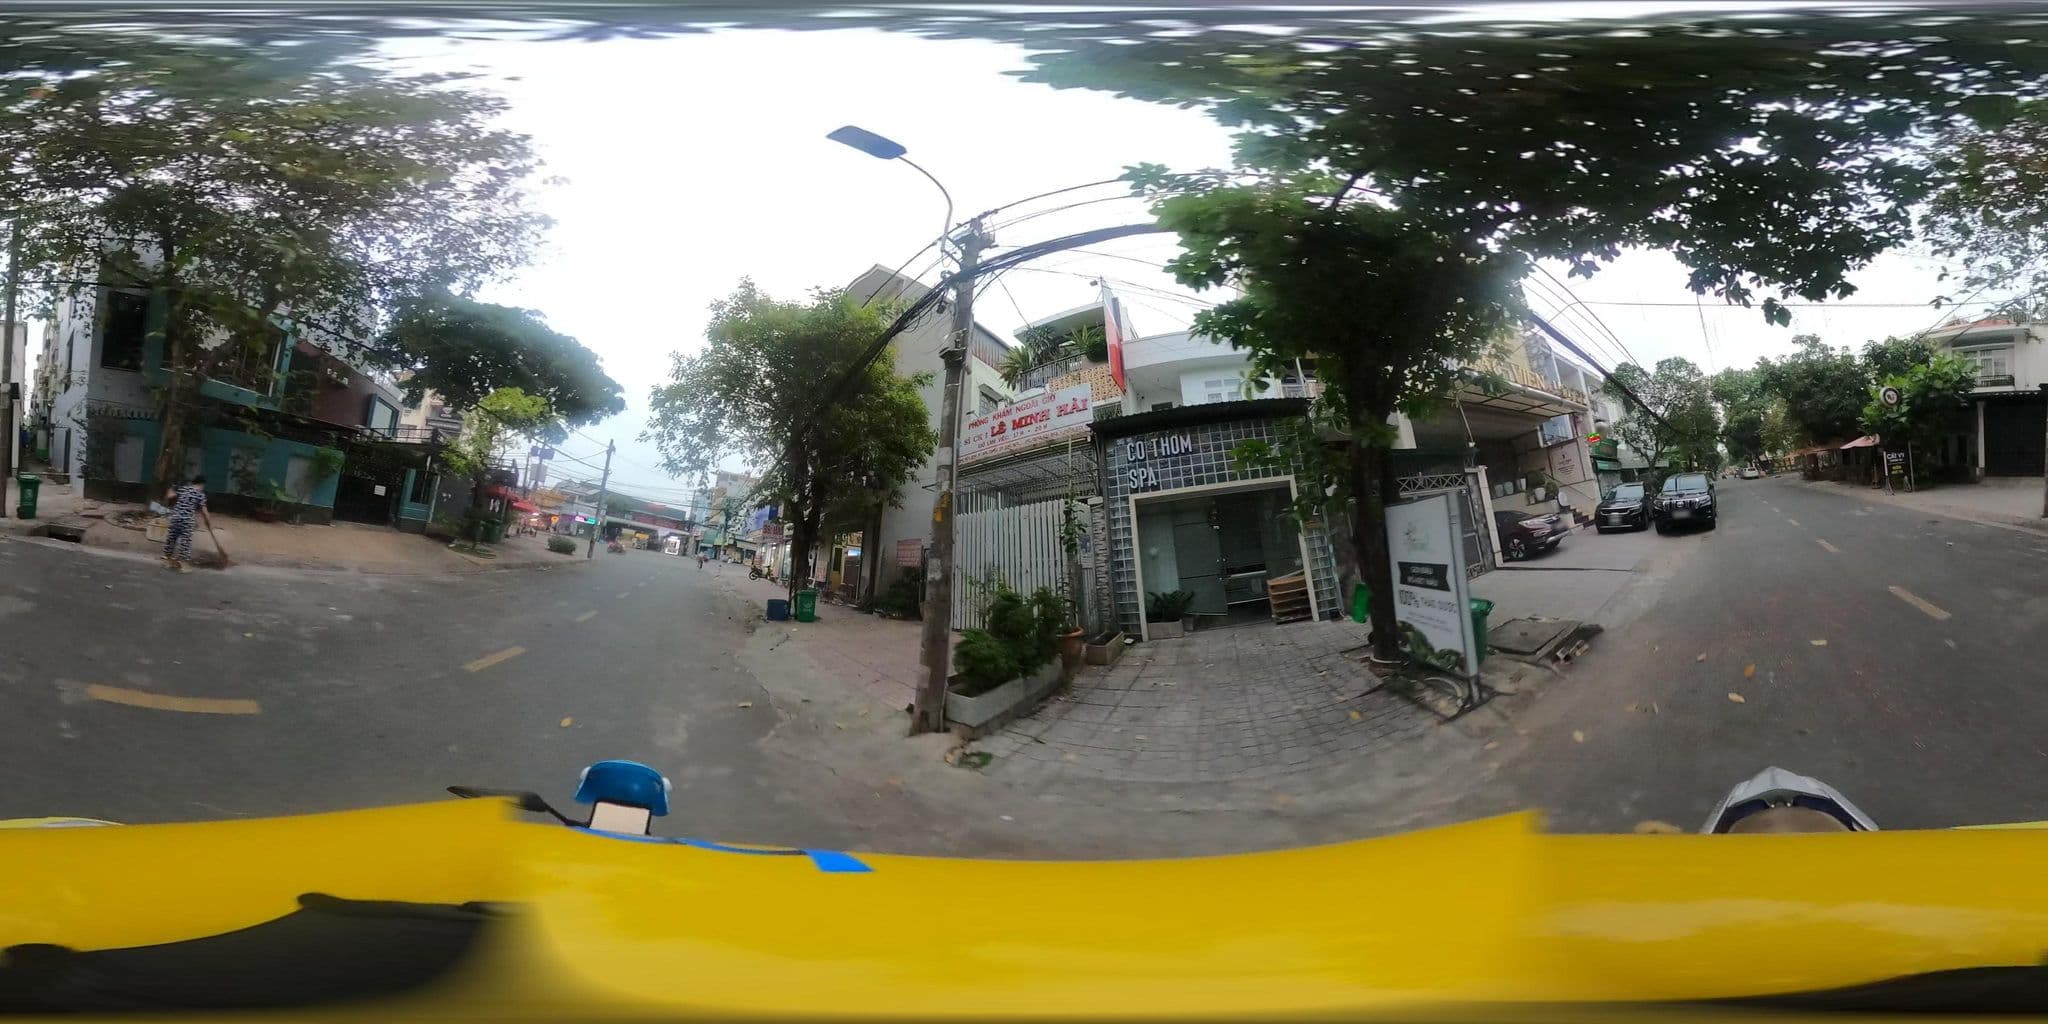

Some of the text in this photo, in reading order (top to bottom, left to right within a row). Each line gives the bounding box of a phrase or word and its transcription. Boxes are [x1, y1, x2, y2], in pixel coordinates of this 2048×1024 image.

[990, 420, 1008, 437] LÊ
[1012, 408, 1051, 431] MINH
[1129, 467, 1158, 489] SPA
